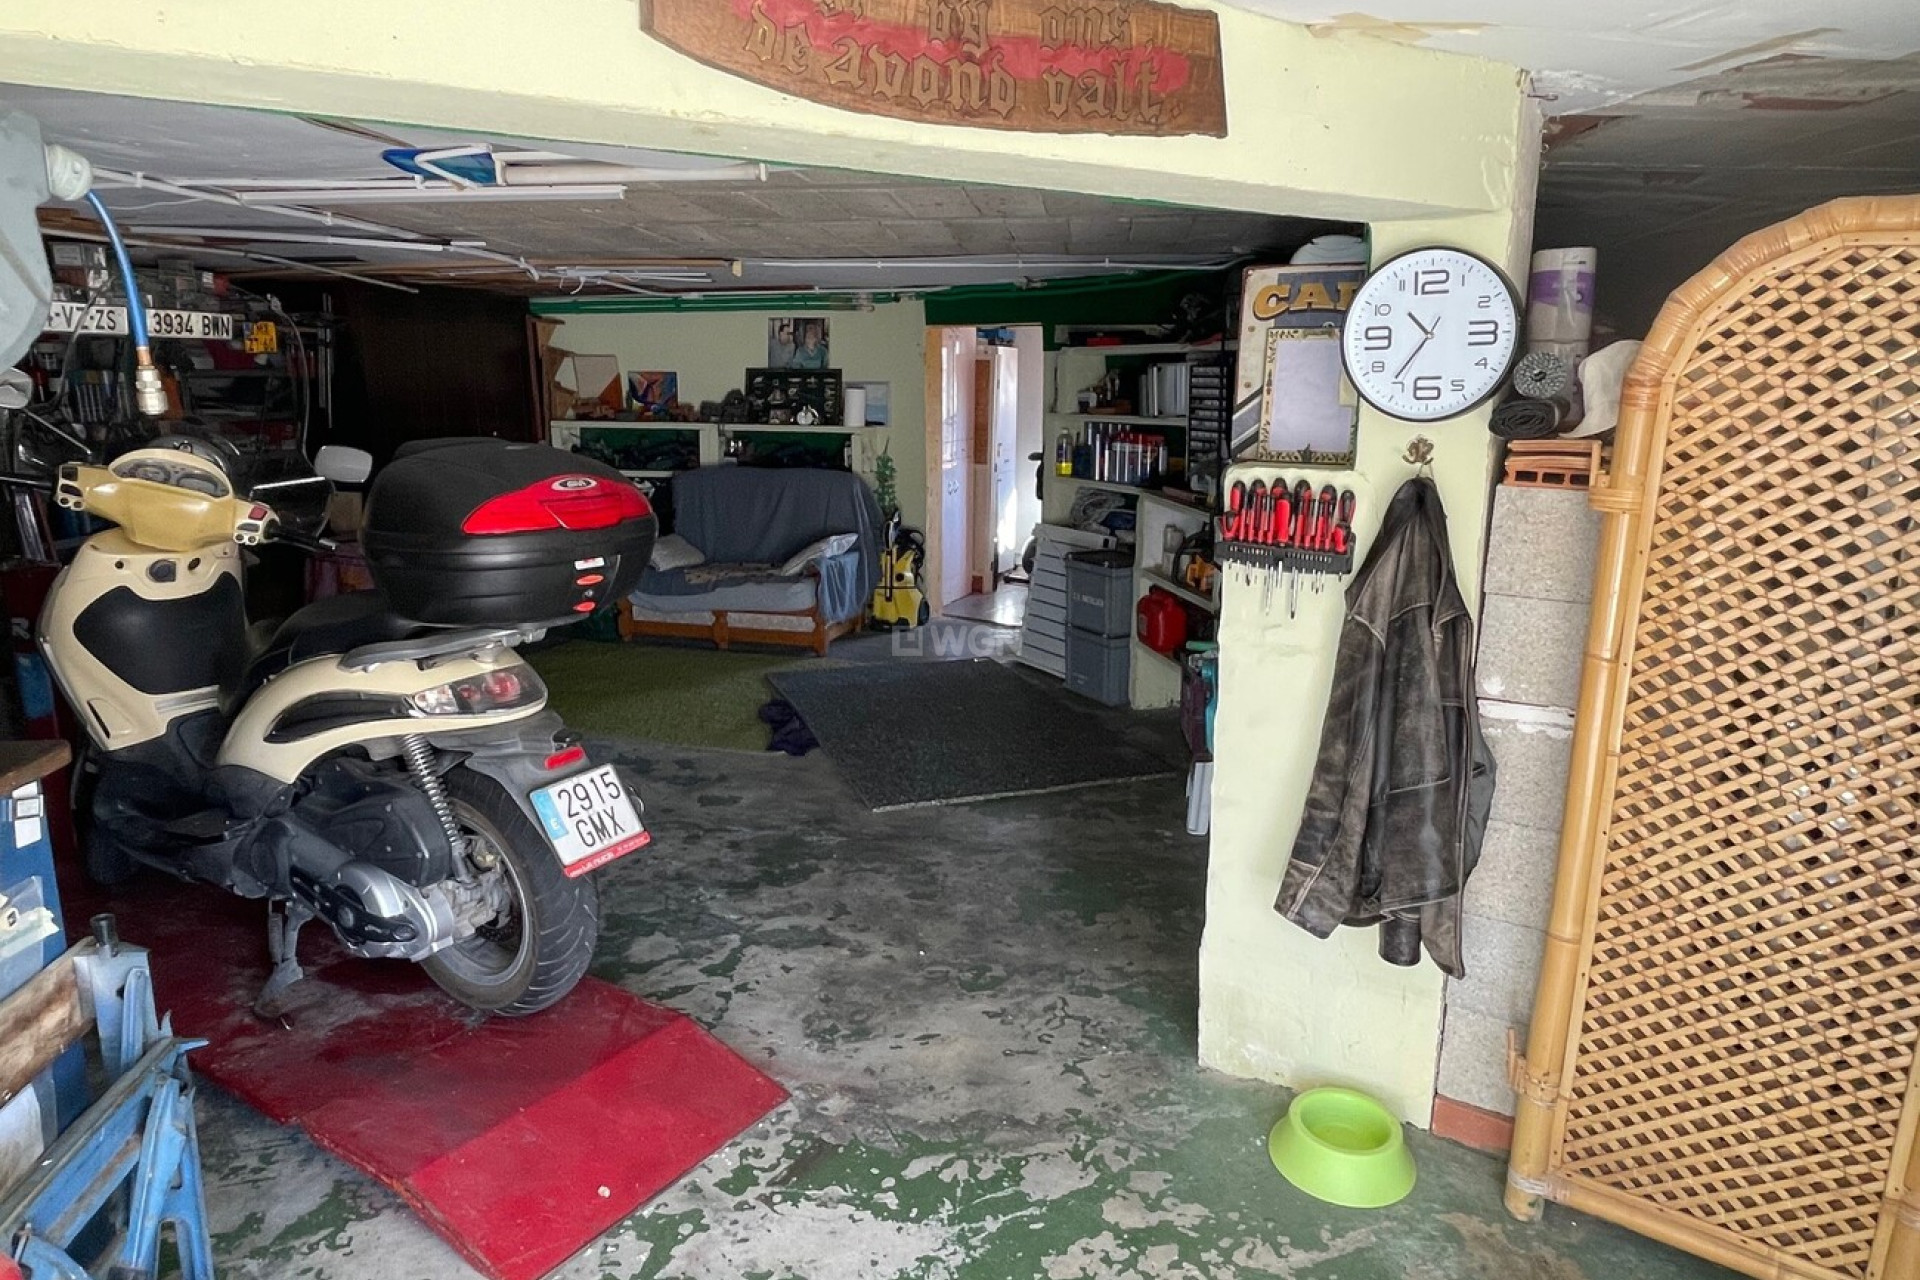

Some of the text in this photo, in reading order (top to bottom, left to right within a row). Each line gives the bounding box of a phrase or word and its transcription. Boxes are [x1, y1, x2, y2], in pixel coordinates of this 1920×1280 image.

[1398, 279, 1406, 292] 11
[1414, 269, 1450, 296] 12
[1461, 274, 1466, 287] 1
[1477, 294, 1491, 309] 2
[1374, 303, 1392, 317] 10
[153, 312, 194, 336] 3934
[1364, 325, 1392, 351] 9
[1467, 319, 1499, 346] 3
[1371, 360, 1385, 373] 8
[1474, 356, 1488, 370] 4
[1391, 380, 1405, 394] 7
[1413, 375, 1442, 401] 6
[1450, 378, 1465, 392] 5
[557, 771, 621, 819] 2915
[575, 805, 626, 848] GMX
